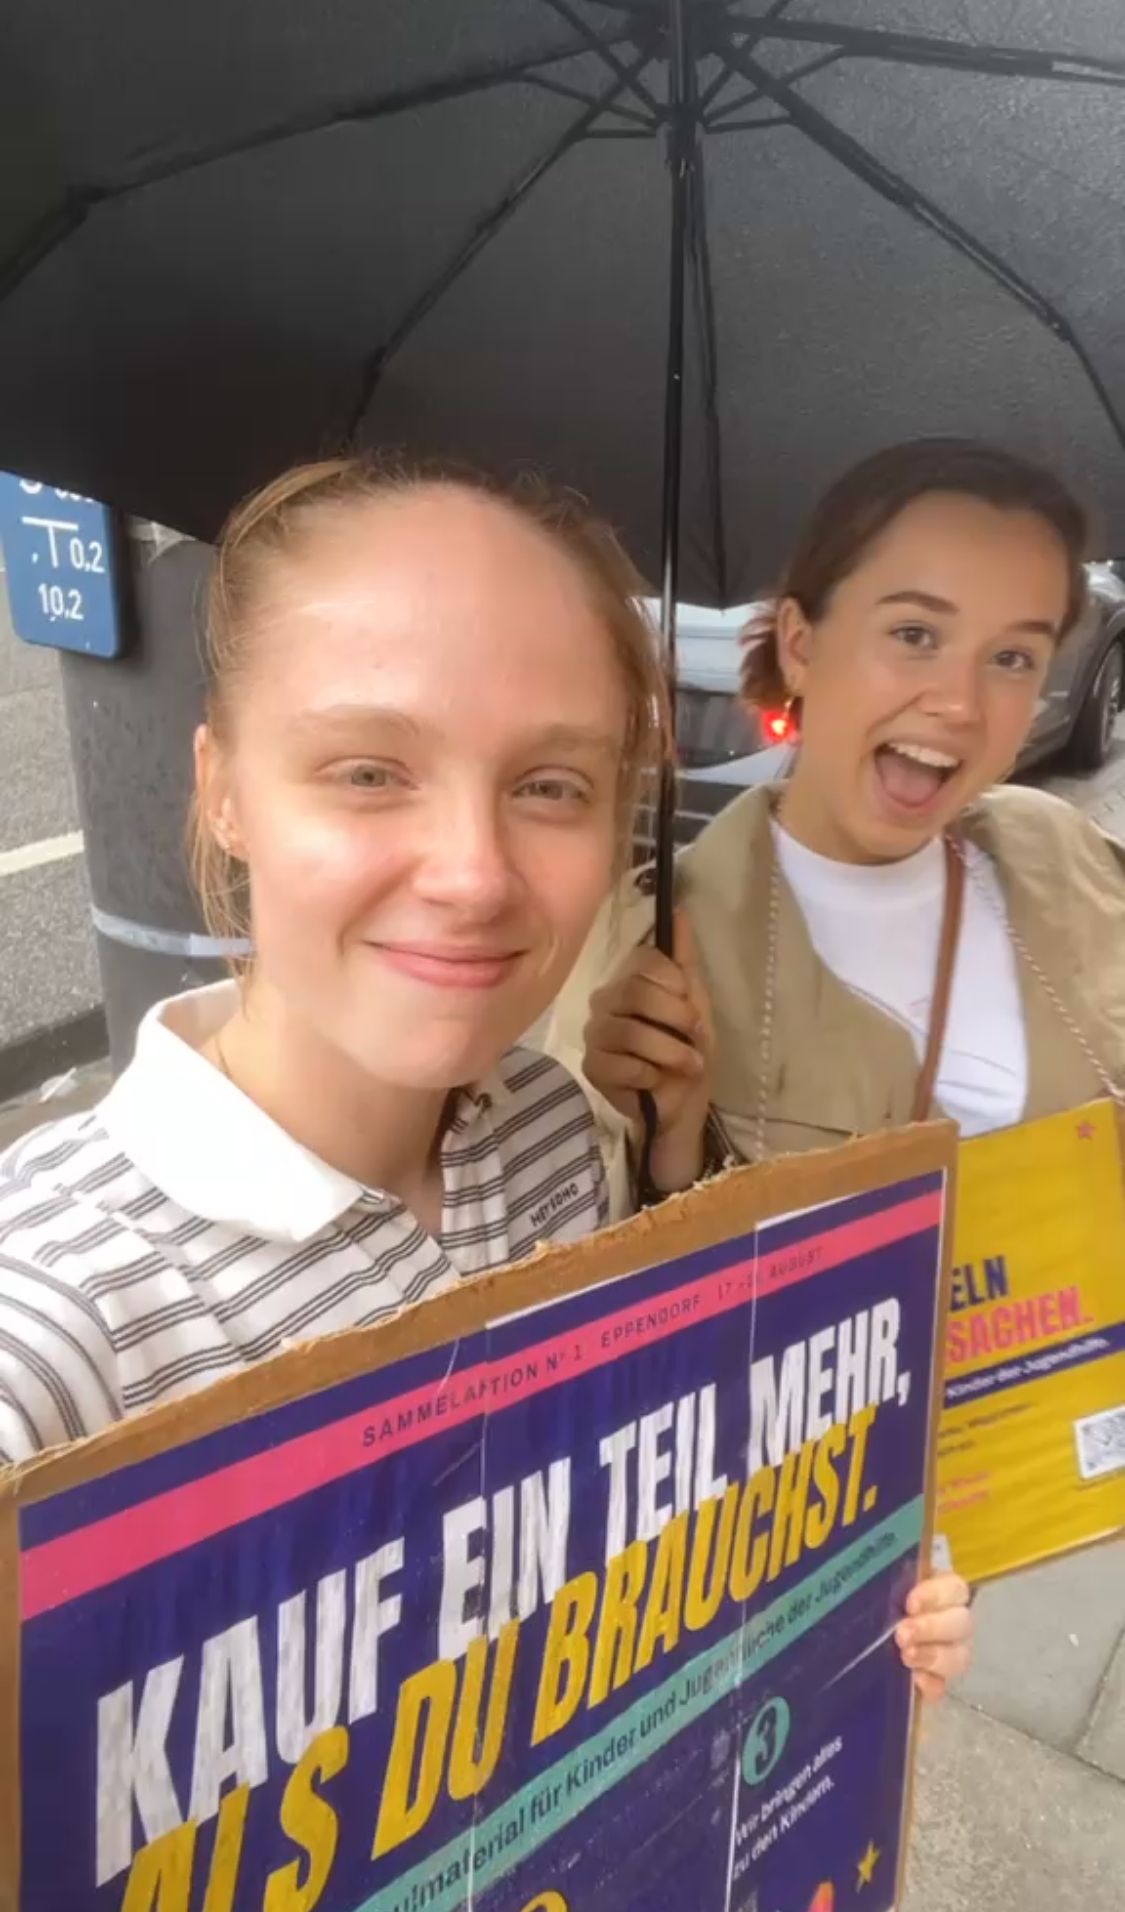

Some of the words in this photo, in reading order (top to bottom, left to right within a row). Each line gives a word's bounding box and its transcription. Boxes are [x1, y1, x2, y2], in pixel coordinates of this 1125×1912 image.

[601, 1294, 700, 1348] EPPENDORF
[96, 1537, 405, 1888] KAUF
[438, 1457, 571, 1661] EIN
[600, 1383, 728, 1570] TEIL
[747, 1297, 911, 1474] MEHR,
[371, 1618, 519, 1861] DU
[530, 1402, 878, 1748] BRAUCHST.
[531, 1785, 563, 1824] für
[566, 1728, 637, 1796] Kinder
[640, 1690, 677, 1738] und
[756, 1704, 777, 1762] 3
